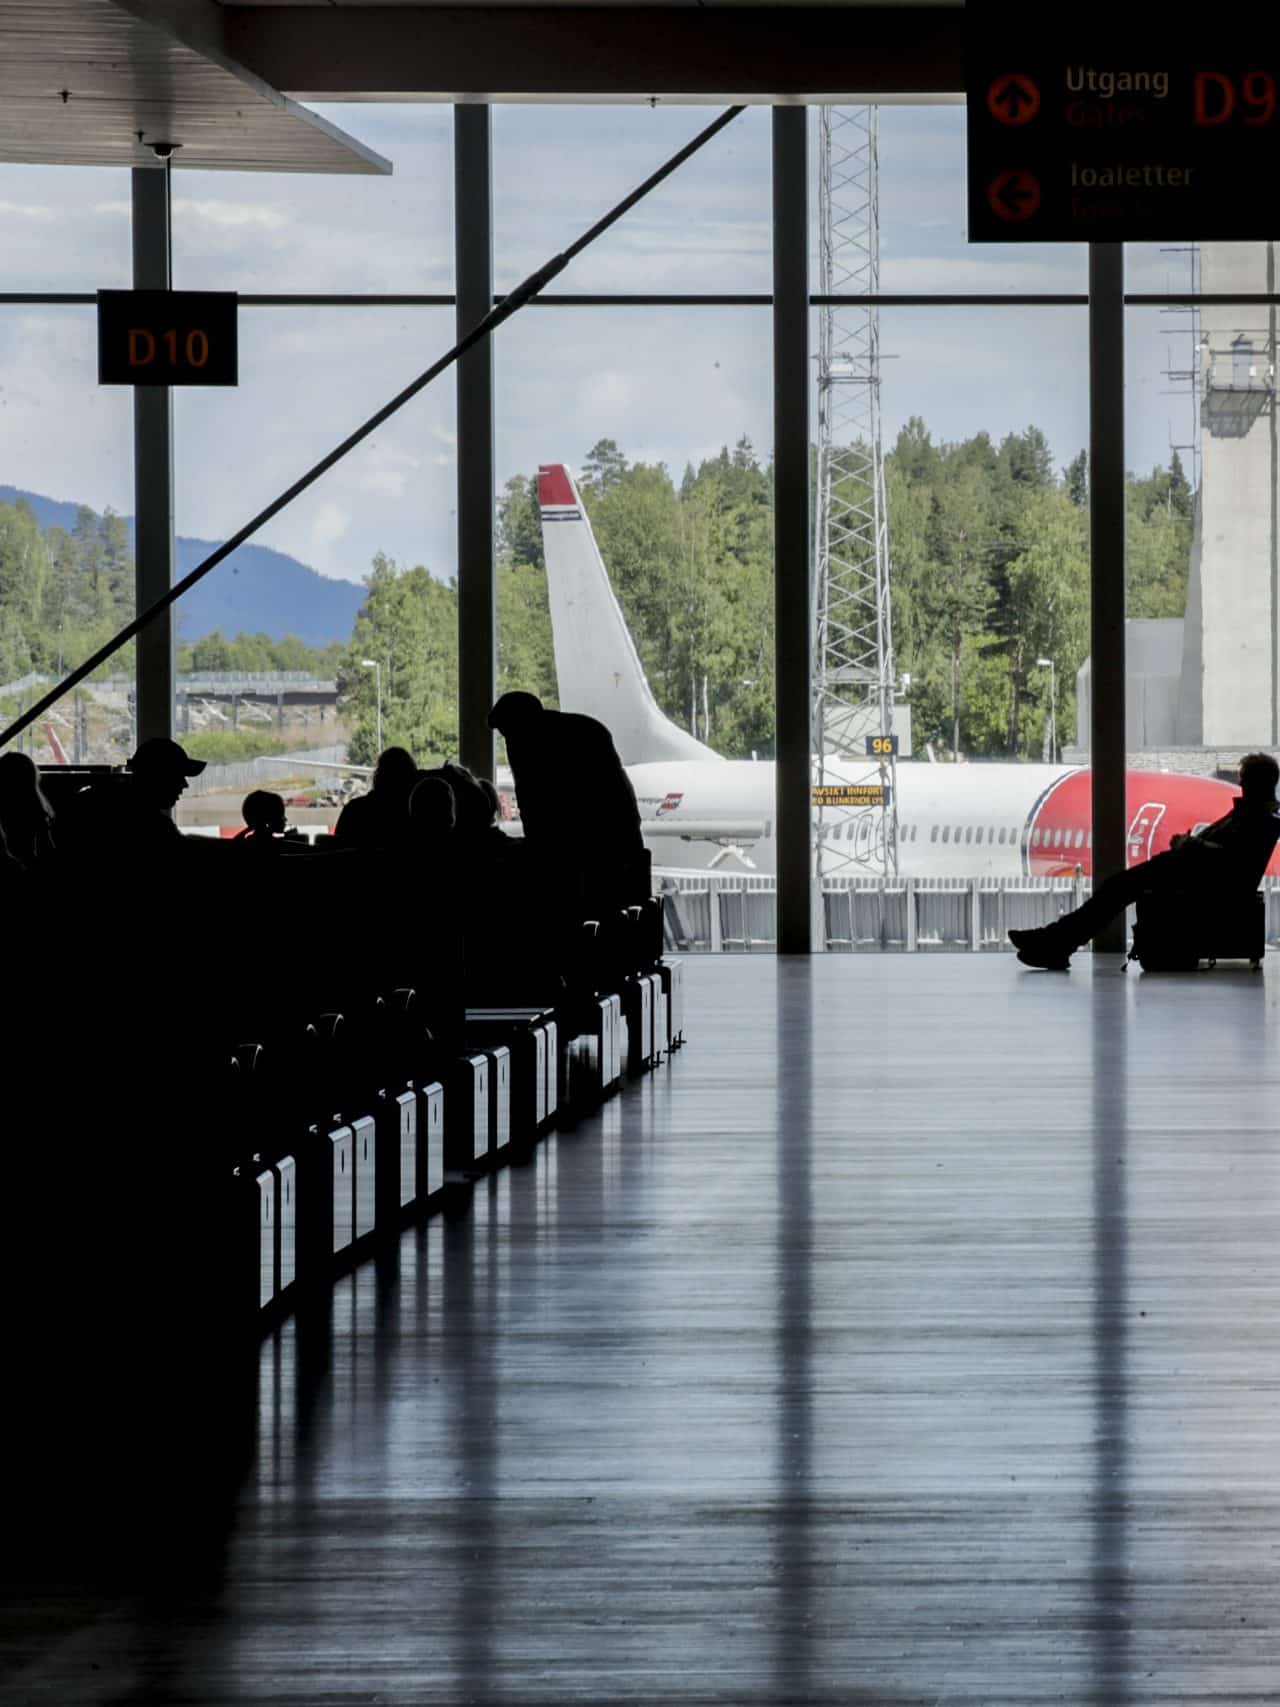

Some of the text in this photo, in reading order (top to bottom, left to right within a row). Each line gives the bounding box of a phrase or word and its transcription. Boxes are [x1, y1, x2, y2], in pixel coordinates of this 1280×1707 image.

[1065, 65, 1169, 99] Utgang
[127, 327, 209, 368] D10
[872, 738, 893, 753] 96
